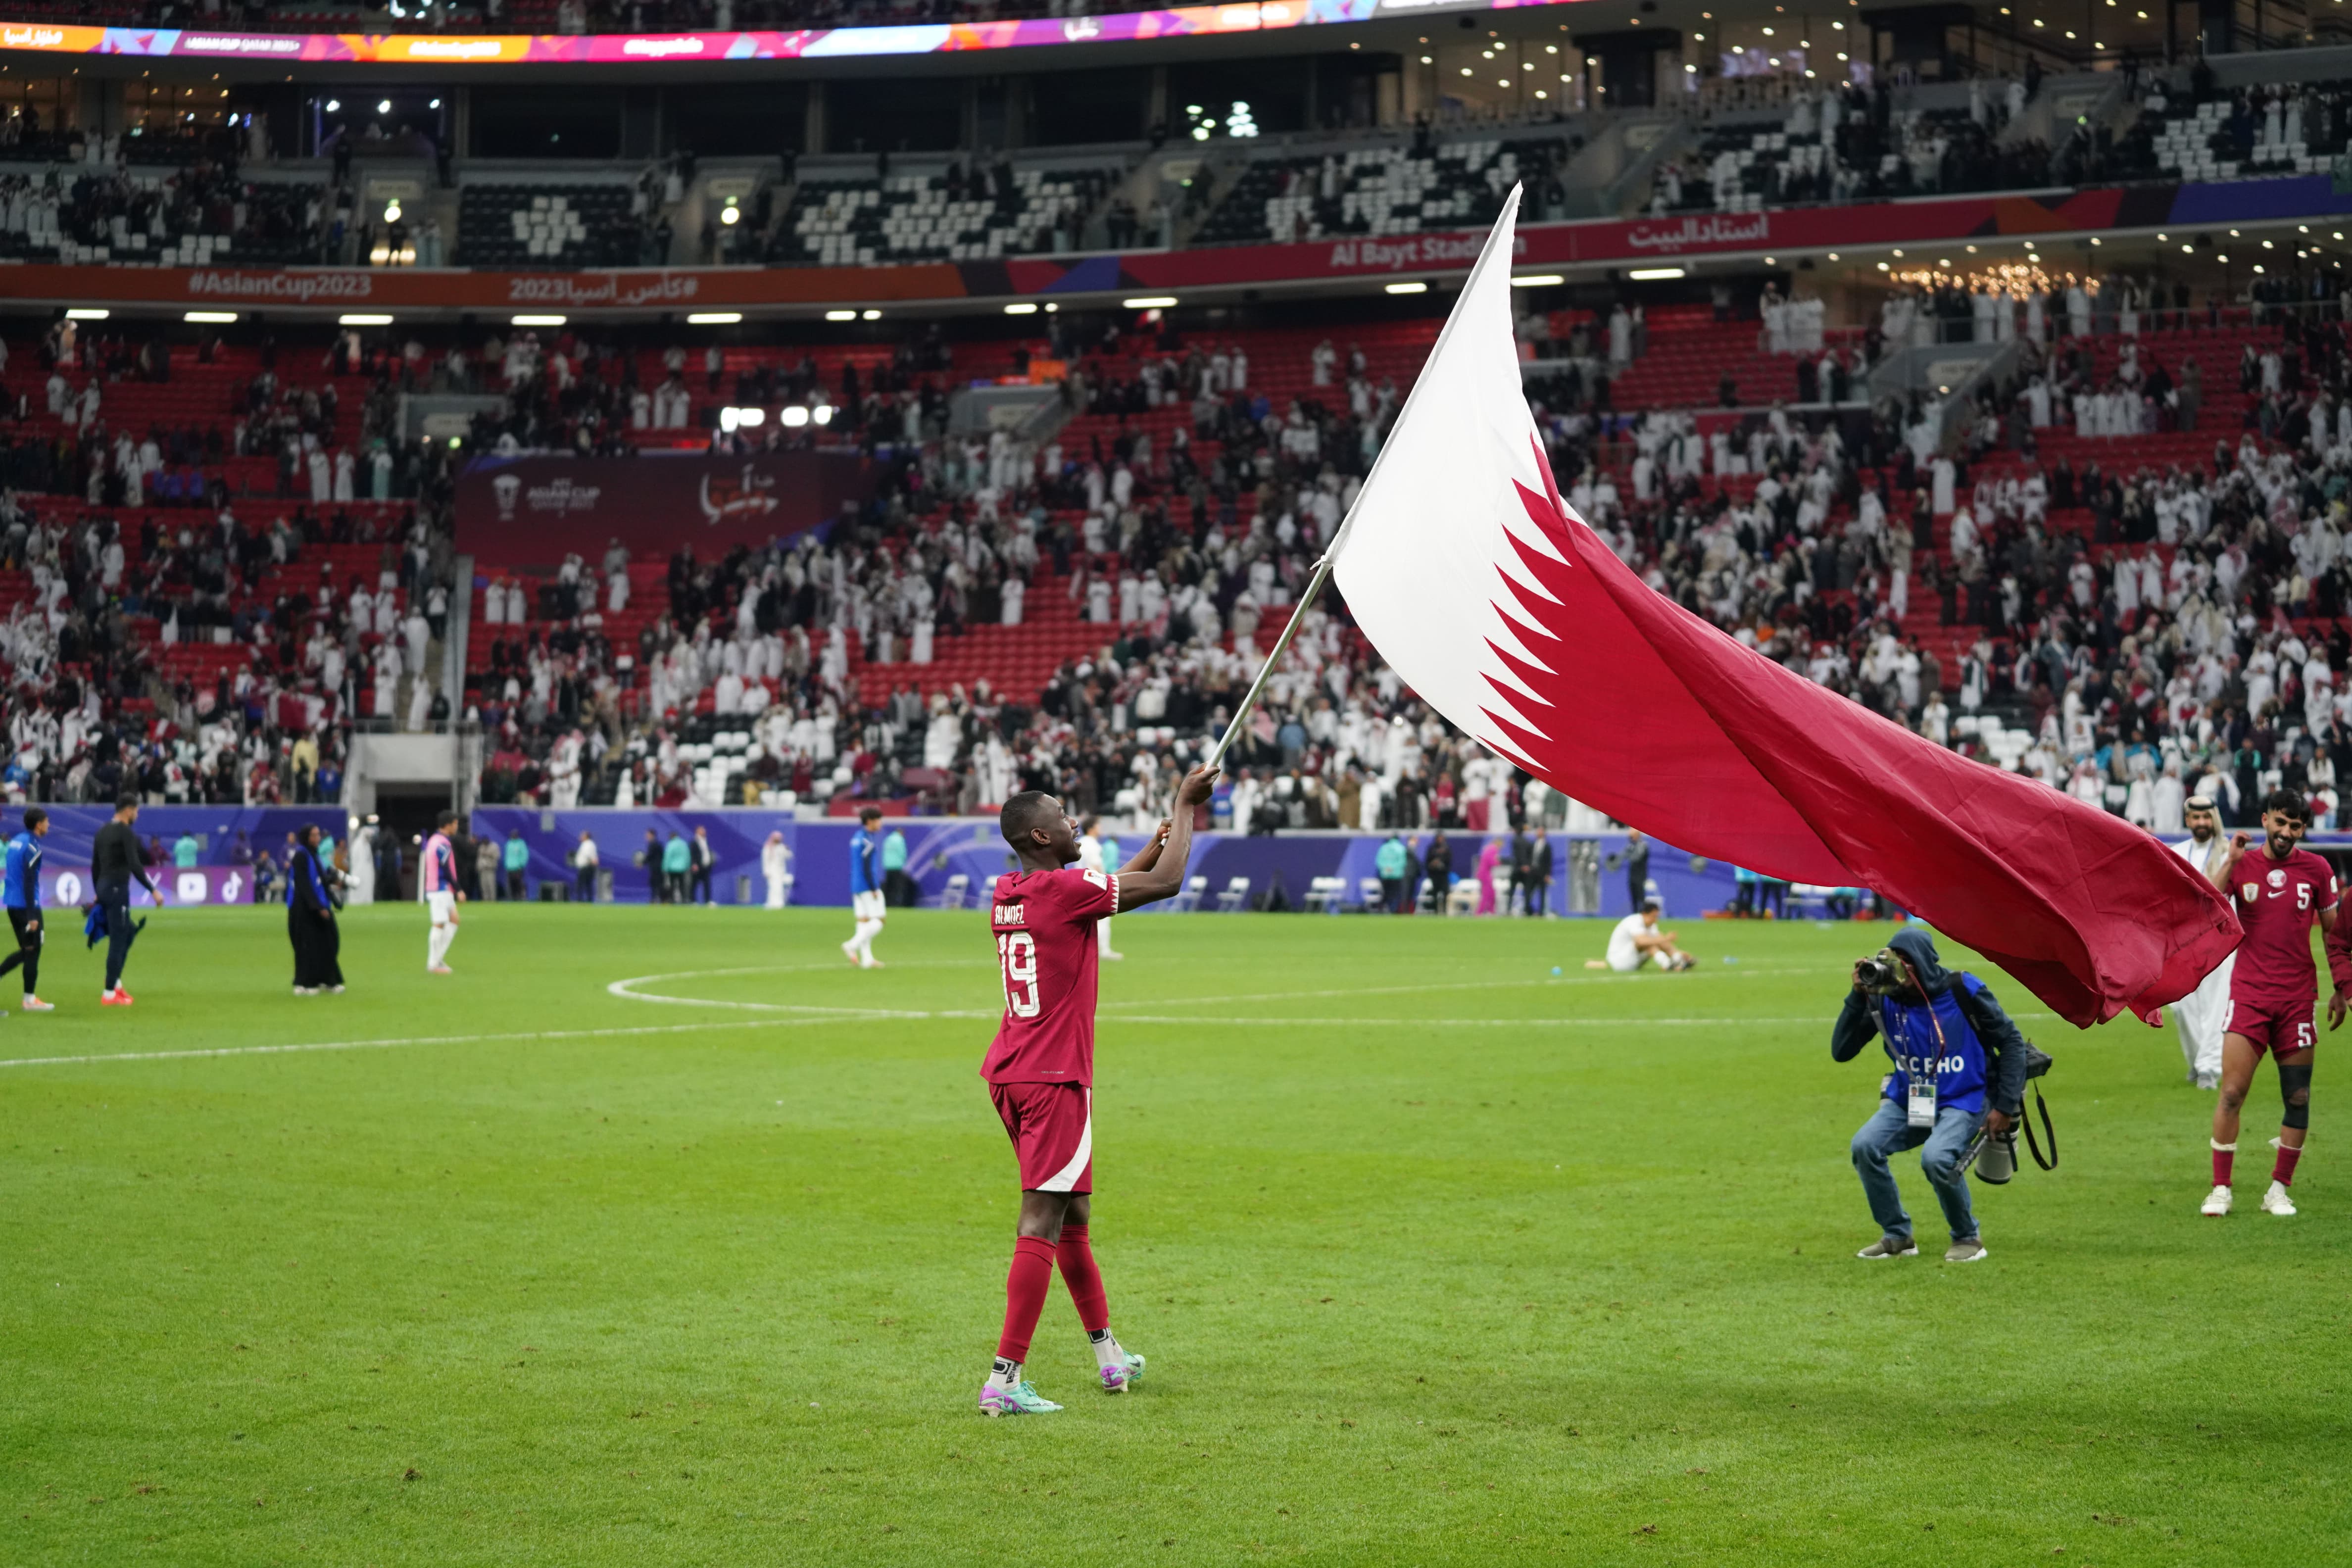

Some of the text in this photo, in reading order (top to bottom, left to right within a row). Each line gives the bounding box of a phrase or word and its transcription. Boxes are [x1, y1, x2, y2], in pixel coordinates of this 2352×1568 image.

[1361, 236, 1418, 270] Bayt
[189, 271, 372, 301] #AsianCup2023
[2297, 883, 2310, 910] 5
[995, 904, 1025, 925] ALMOEZ
[998, 931, 1040, 1018] 19
[2298, 1023, 2311, 1048] 5
